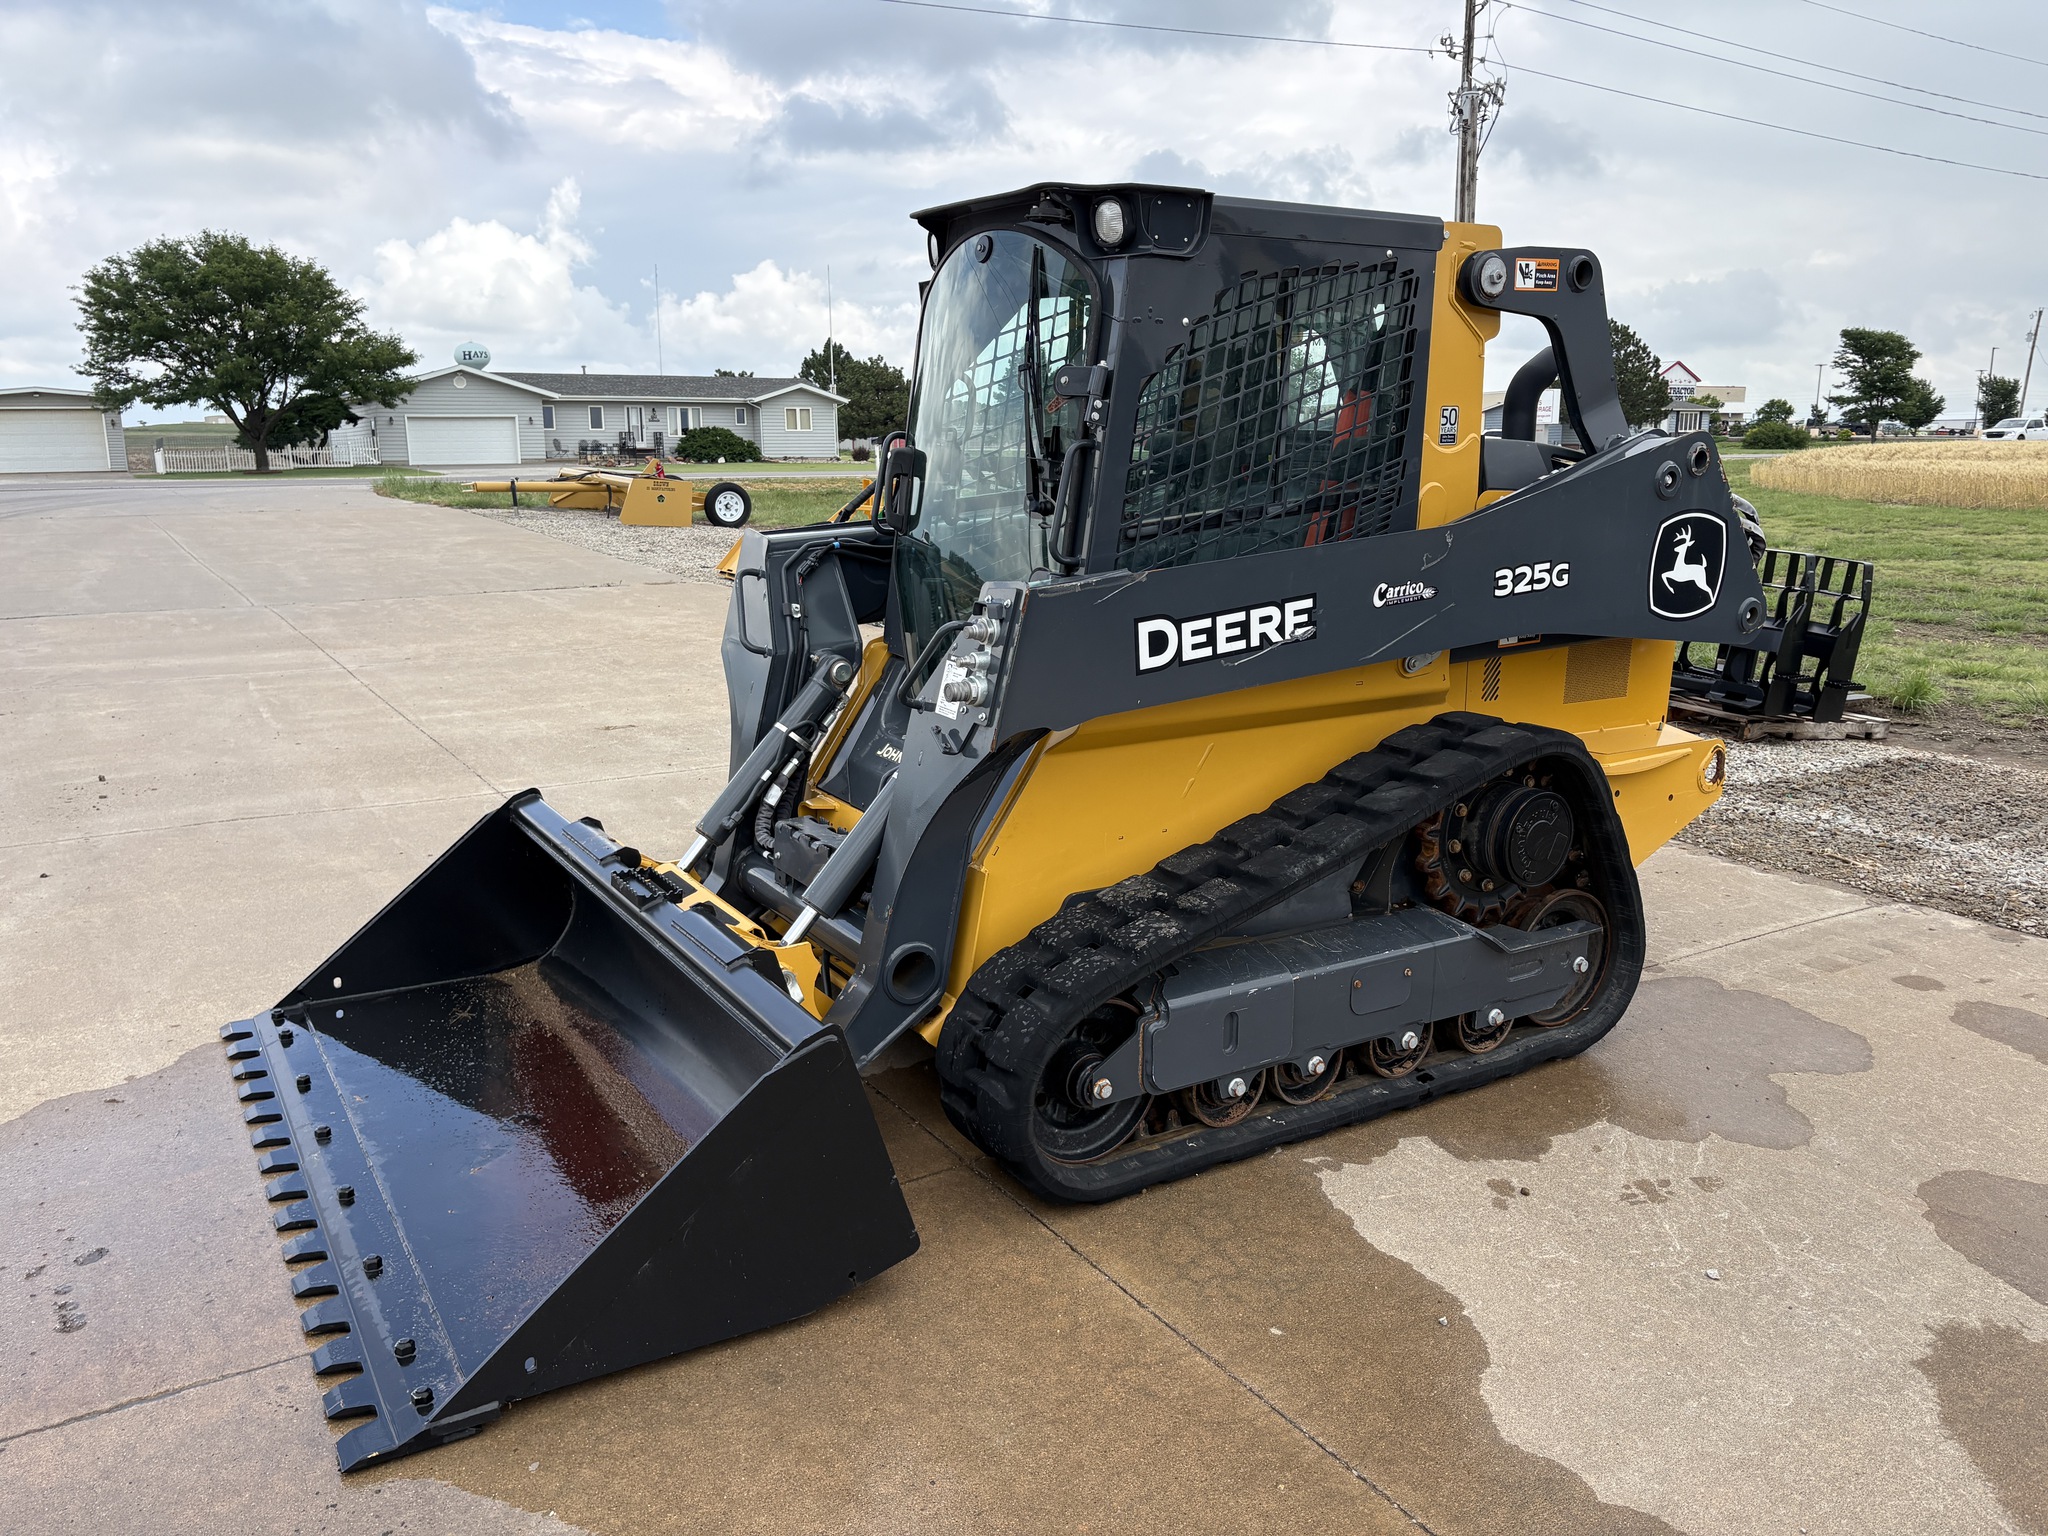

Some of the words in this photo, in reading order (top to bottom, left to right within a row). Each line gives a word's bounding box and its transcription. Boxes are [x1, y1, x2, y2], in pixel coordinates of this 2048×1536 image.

[462, 350, 489, 360] HAYS
[1668, 387, 1695, 395] TRACTOR
[1441, 408, 1457, 426] 50
[1494, 562, 1569, 597] 325G
[1373, 580, 1424, 608] Carrico
[1386, 596, 1421, 606] IMPLEMENT
[1137, 597, 1317, 671] DEERE
